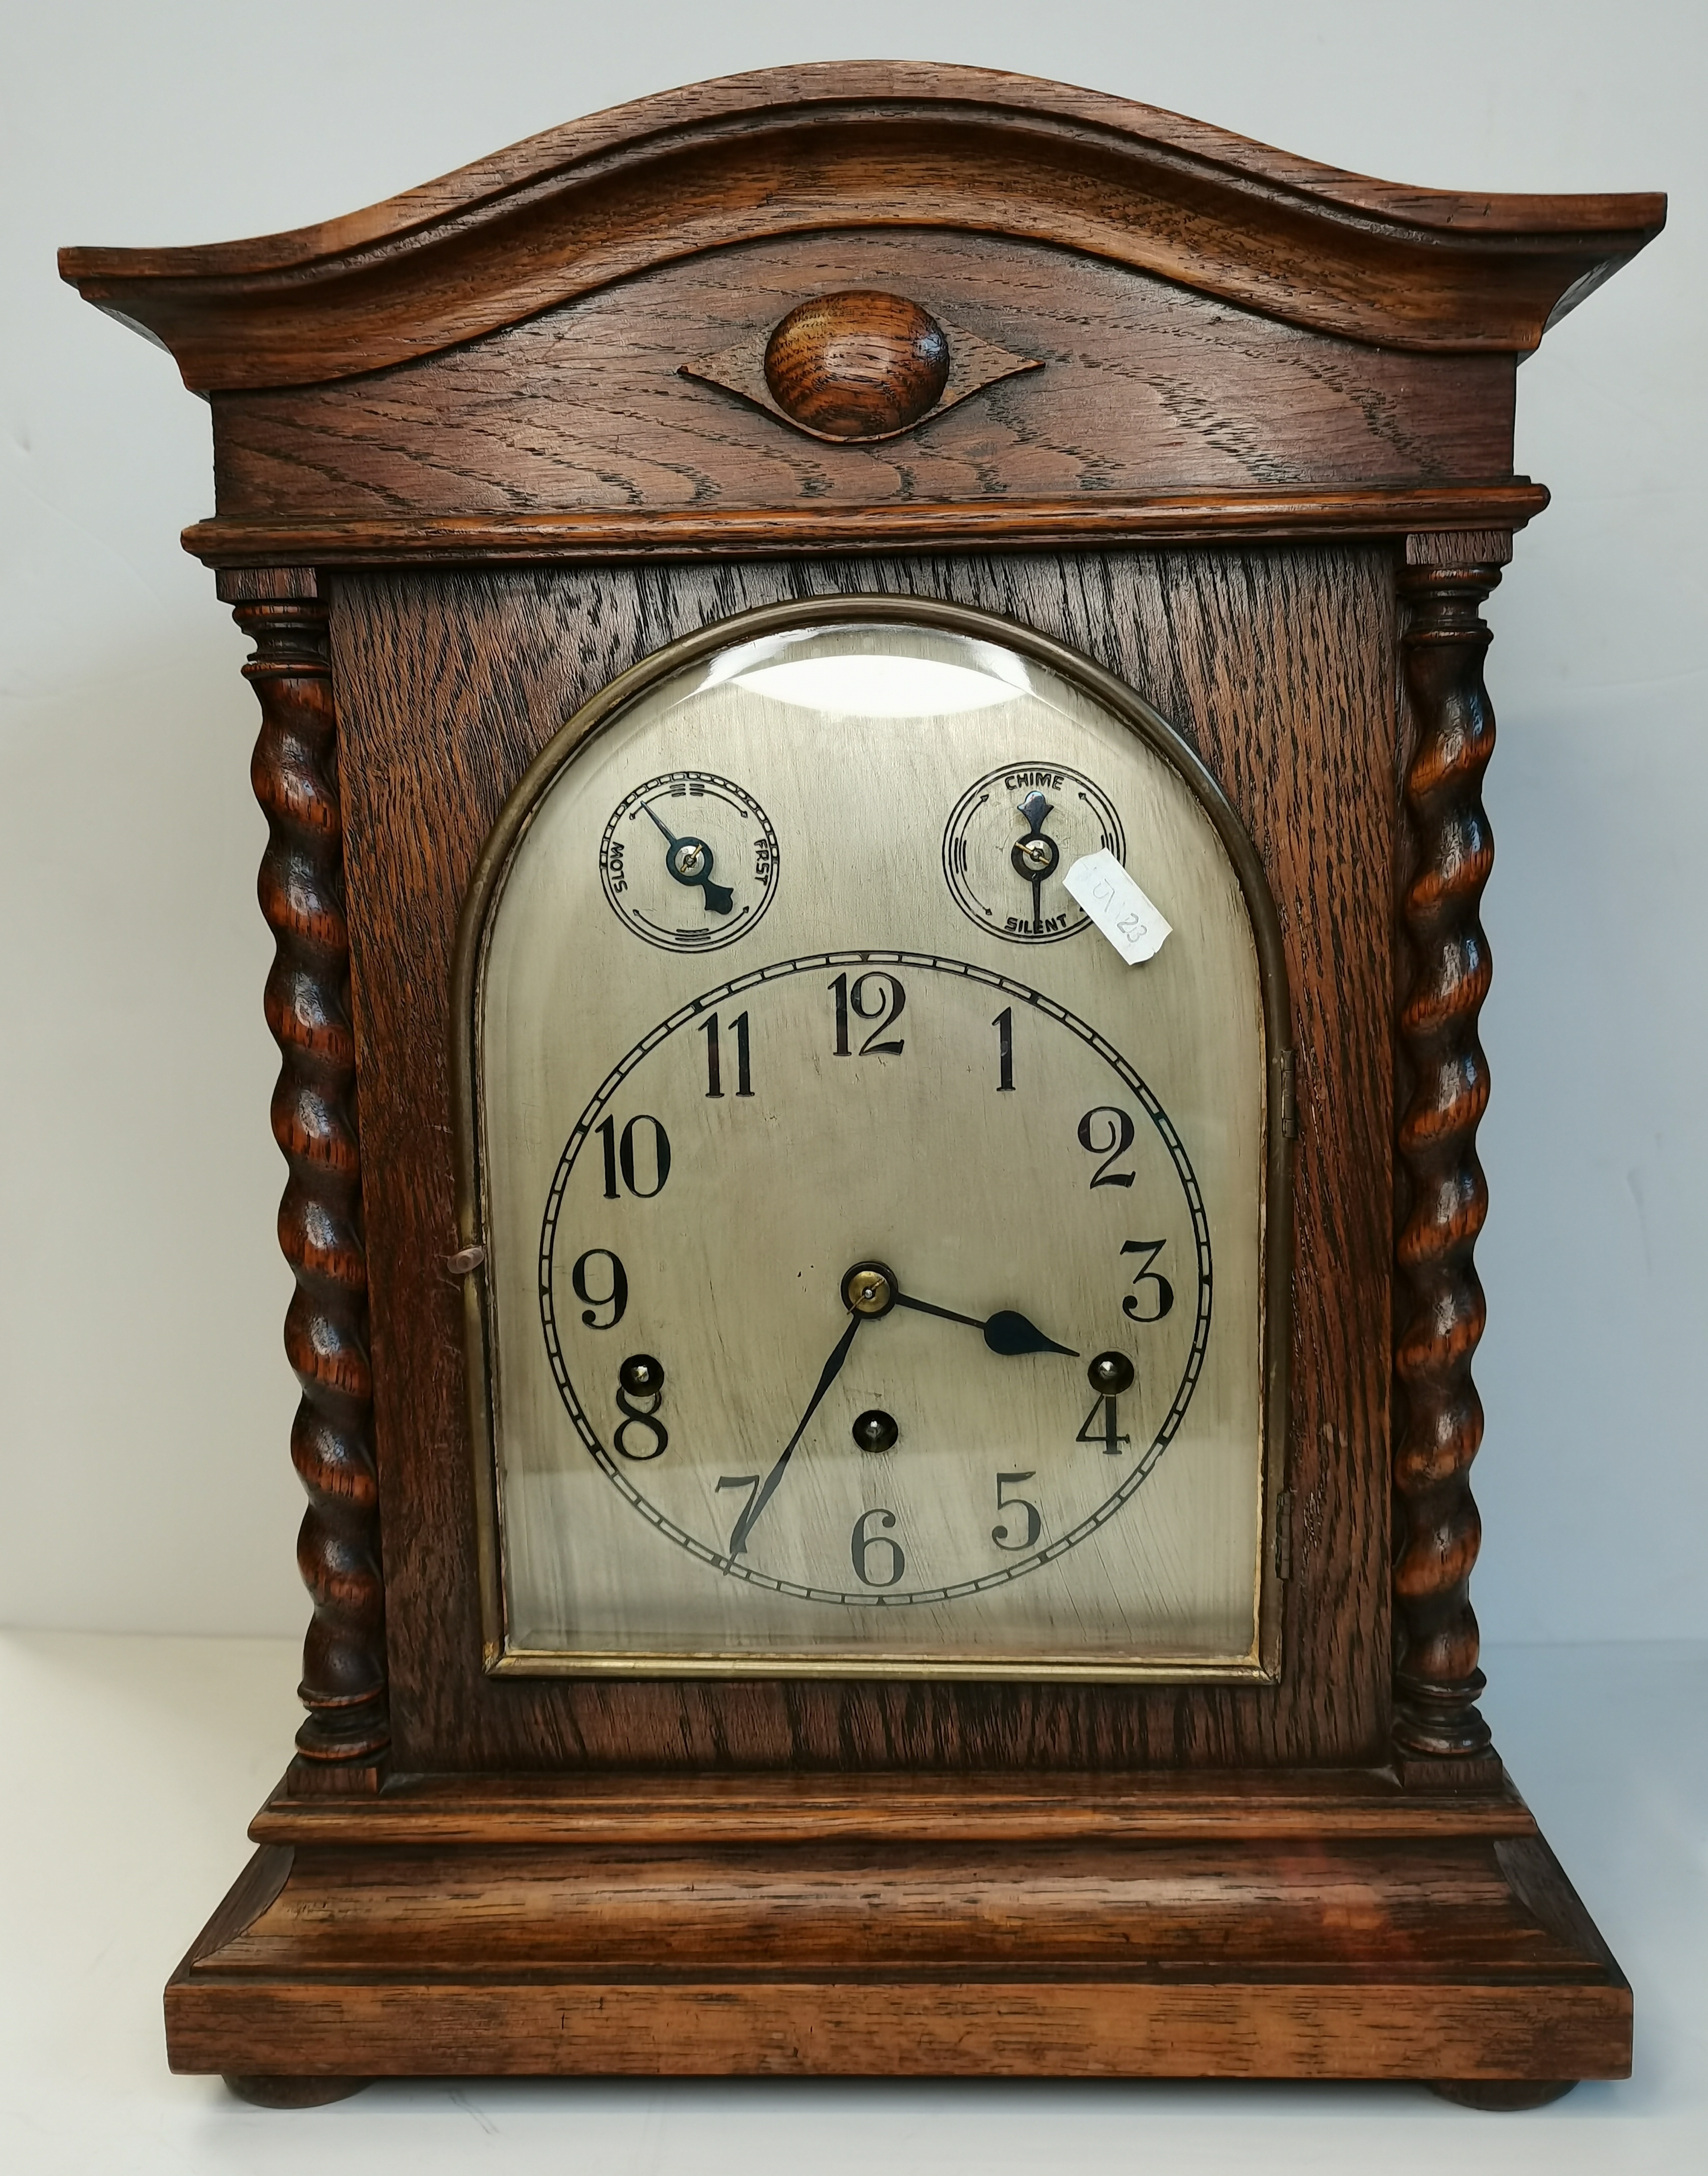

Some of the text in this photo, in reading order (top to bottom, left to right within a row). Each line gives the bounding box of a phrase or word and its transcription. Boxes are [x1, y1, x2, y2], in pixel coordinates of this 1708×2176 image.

[1004, 772, 1065, 790] CHIME
[610, 841, 628, 893] SLOW
[1004, 913, 1067, 935] SILENT
[828, 972, 906, 1057] 12
[992, 1007, 1016, 1092] 1
[698, 1012, 755, 1098] 11
[595, 1114, 672, 1199] 10
[1077, 1106, 1136, 1190] 2
[572, 1249, 628, 1330] 9
[1120, 1239, 1174, 1323] 3
[613, 1381, 669, 1461] 8
[1076, 1392, 1130, 1455] 4
[715, 1474, 760, 1554] 7
[851, 1508, 905, 1587] 6
[991, 1471, 1042, 1551] 5
